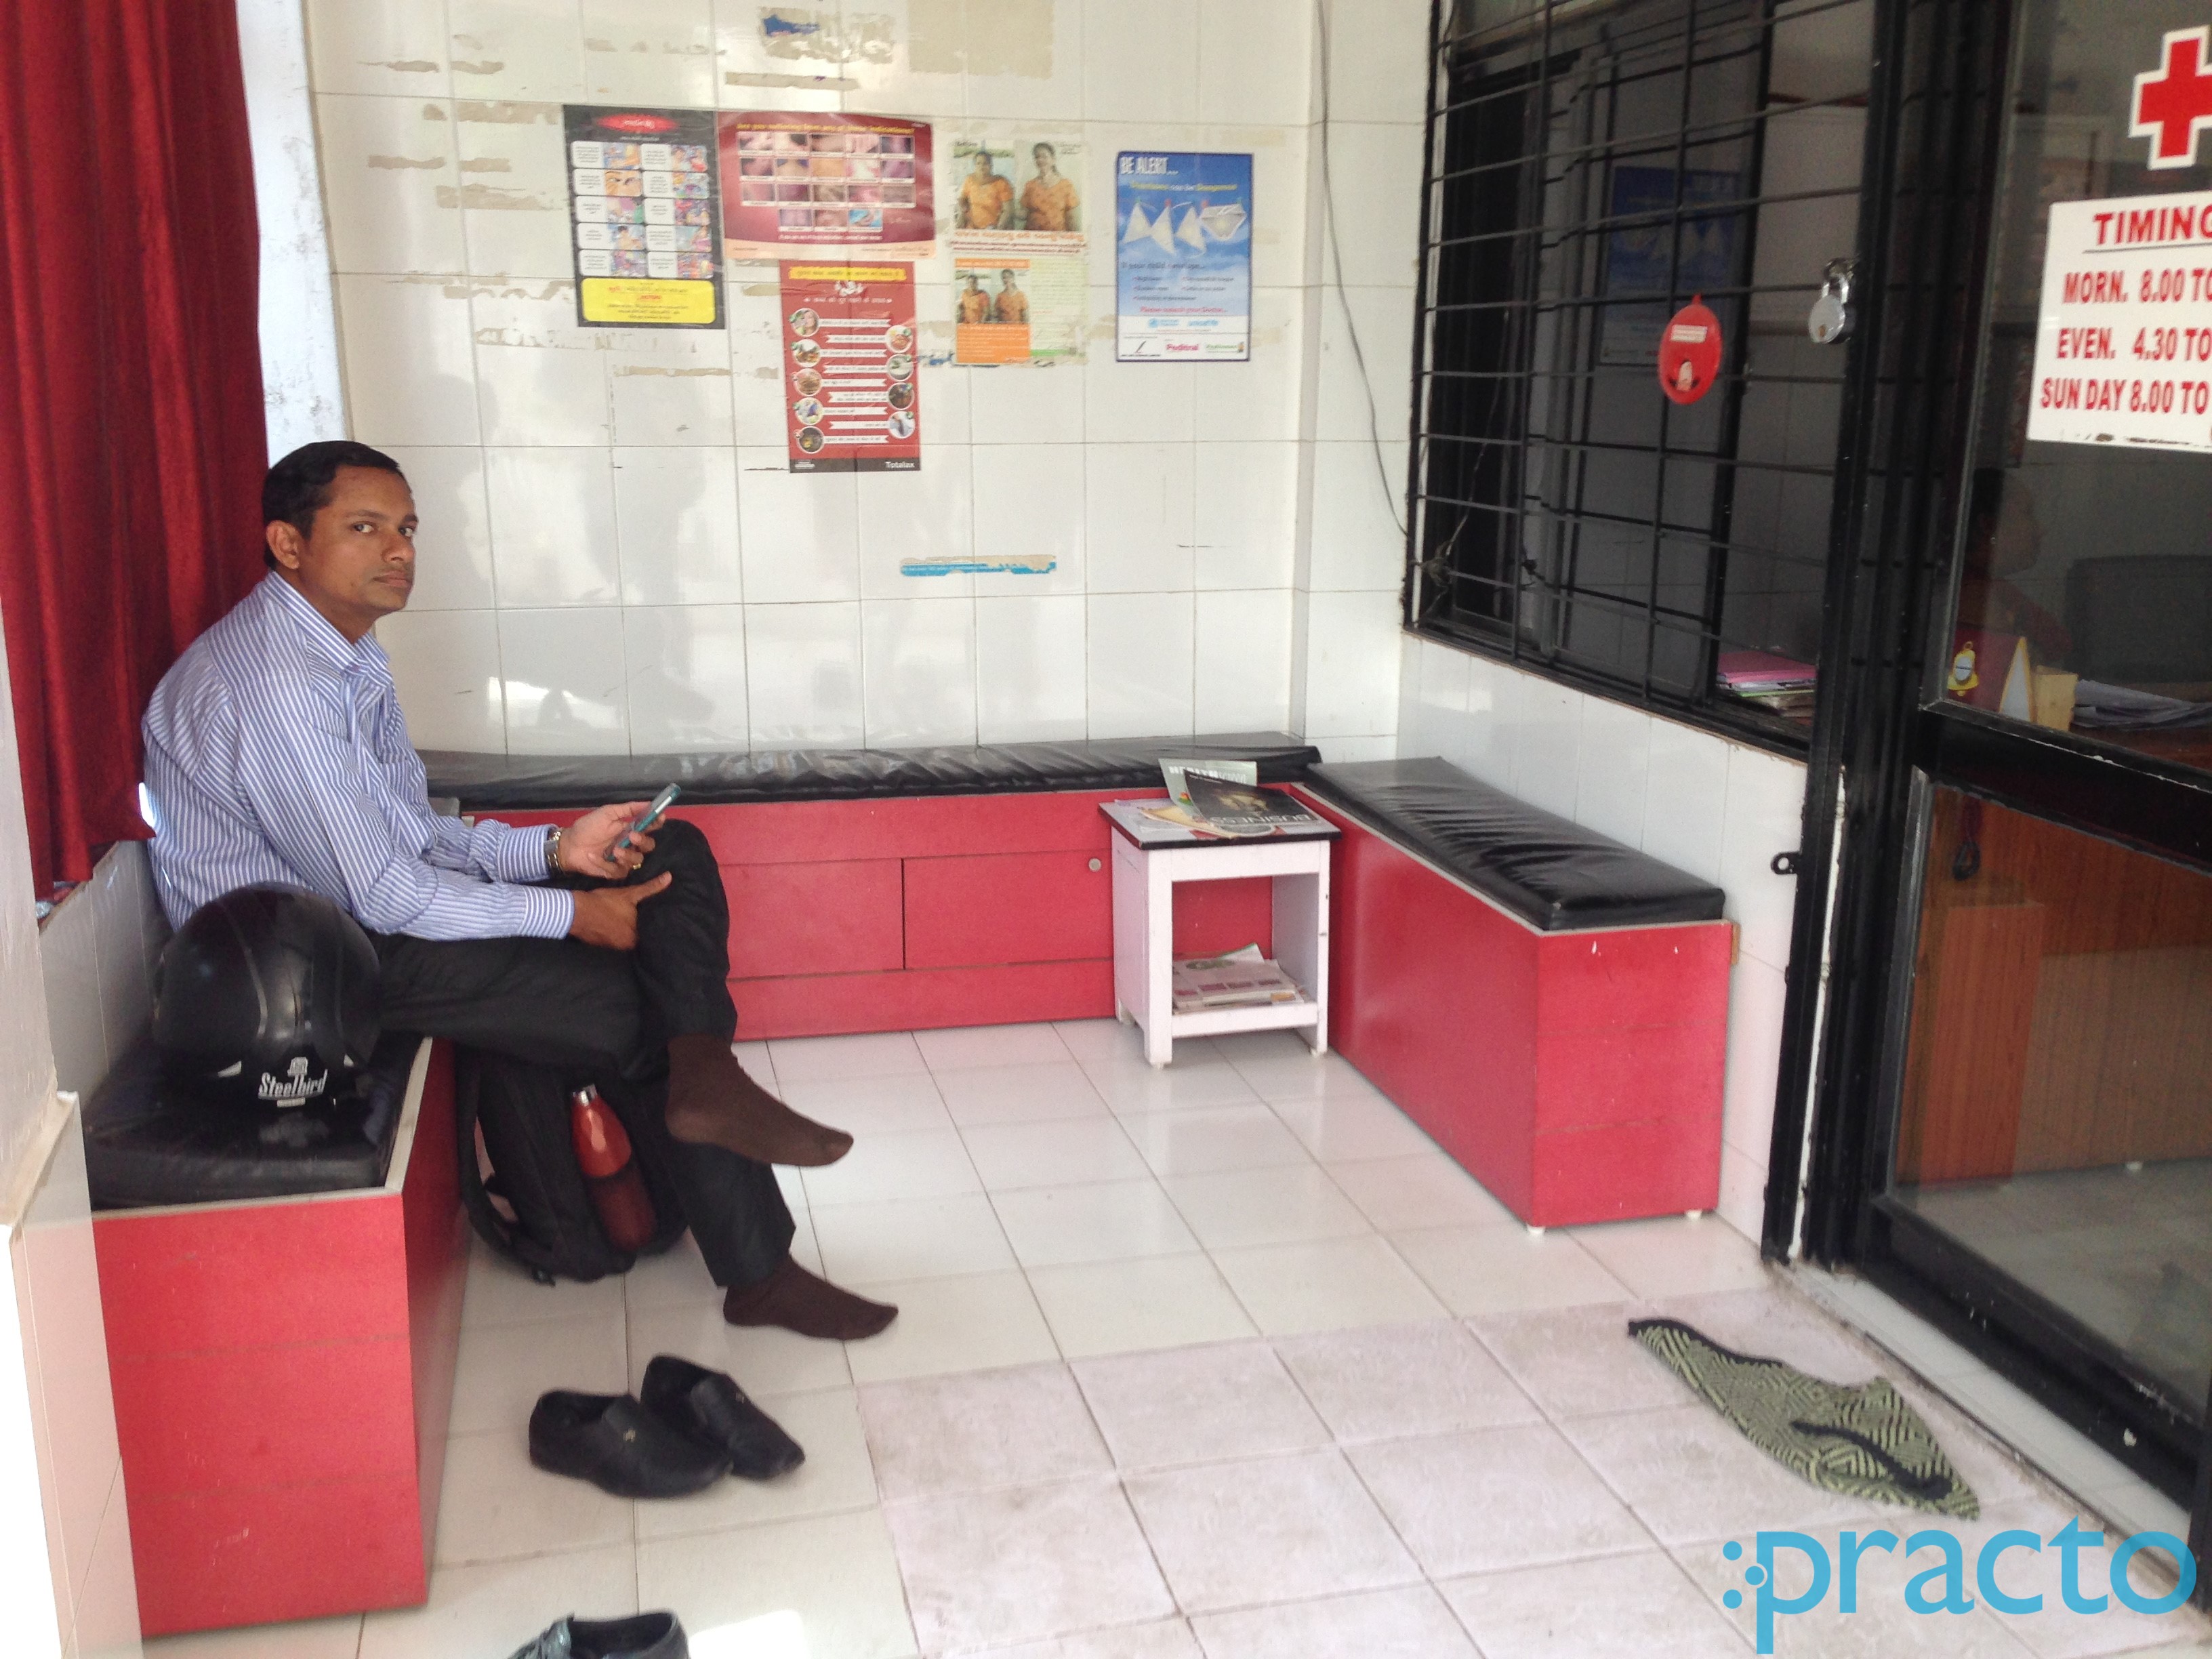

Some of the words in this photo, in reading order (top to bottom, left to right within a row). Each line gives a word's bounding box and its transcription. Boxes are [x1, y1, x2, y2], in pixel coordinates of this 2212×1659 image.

[1120, 156, 1134, 174] BE
[2062, 270, 2129, 303] MORN.
[2140, 268, 2185, 302] 8.00
[2057, 327, 2116, 359] EVEN.
[2133, 327, 2178, 361] 4.30
[2183, 327, 2212, 361] TO
[2129, 379, 2175, 413] 8.00
[2181, 381, 2209, 415] TO
[258, 1069, 328, 1097] Steelbird
